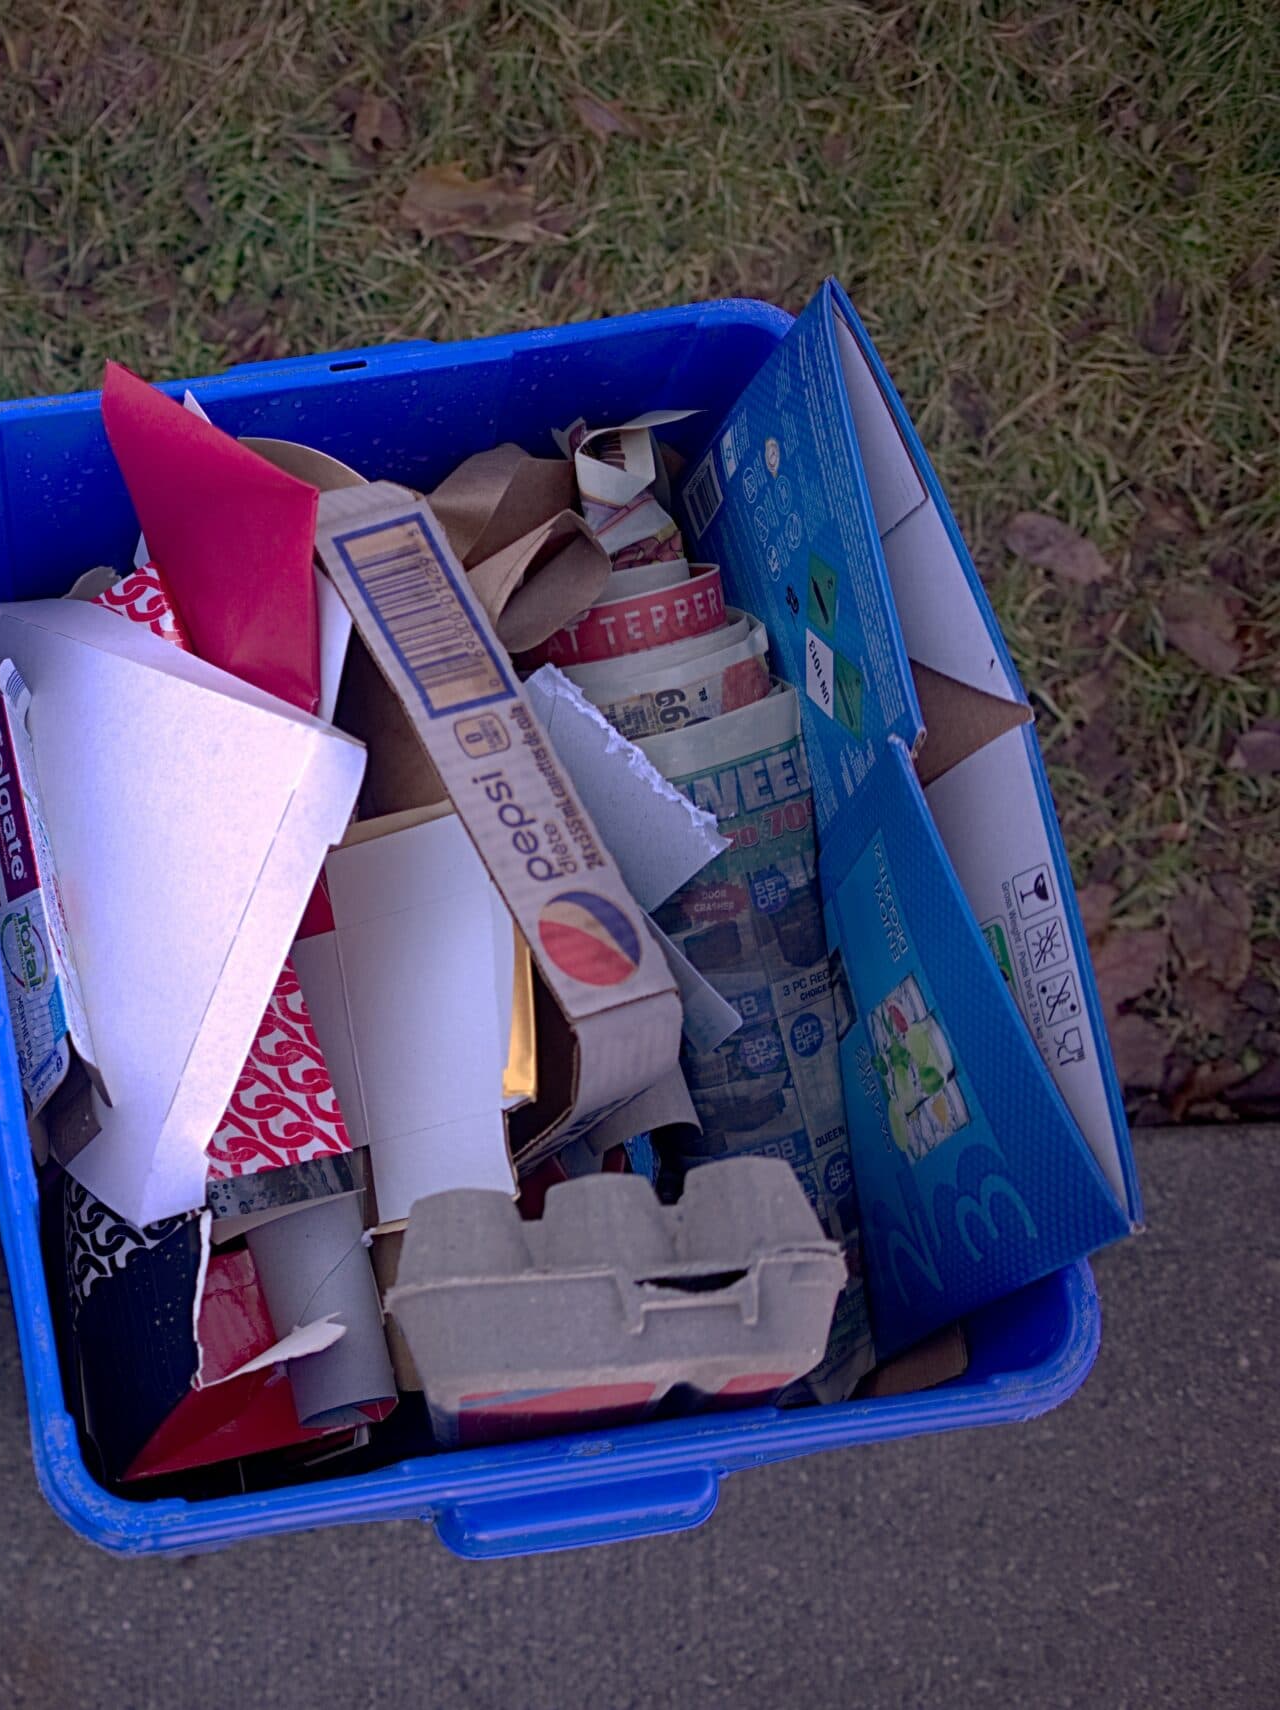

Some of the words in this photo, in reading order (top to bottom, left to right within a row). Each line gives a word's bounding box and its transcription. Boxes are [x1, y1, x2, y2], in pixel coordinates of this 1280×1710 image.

[419, 553, 457, 607] 01429
[448, 608, 486, 661] 69000
[807, 638, 825, 678] 1013
[817, 679, 831, 704] UN
[505, 702, 533, 734] cola
[463, 728, 484, 747] 0
[518, 728, 540, 750] de
[528, 745, 568, 801] canettes
[553, 796, 578, 822] mL
[472, 761, 565, 892] pepsi
[562, 814, 591, 847] 355
[537, 819, 580, 878] diète
[581, 848, 605, 873] 24
[754, 887, 789, 909] OFF
[1000, 880, 1014, 909] Gross
[1006, 910, 1023, 943] Weight
[16, 905, 43, 987] Total
[1016, 950, 1031, 977] Poids
[781, 984, 791, 997] 3
[791, 975, 808, 993] PC
[798, 984, 827, 1001] CHOICE
[1022, 978, 1037, 1000] brut
[794, 1031, 822, 1053] OFF
[744, 1047, 782, 1069] OFF
[814, 1124, 846, 1148] QUEEN
[829, 1168, 851, 1190] OFF
[942, 1164, 1041, 1265] 3
